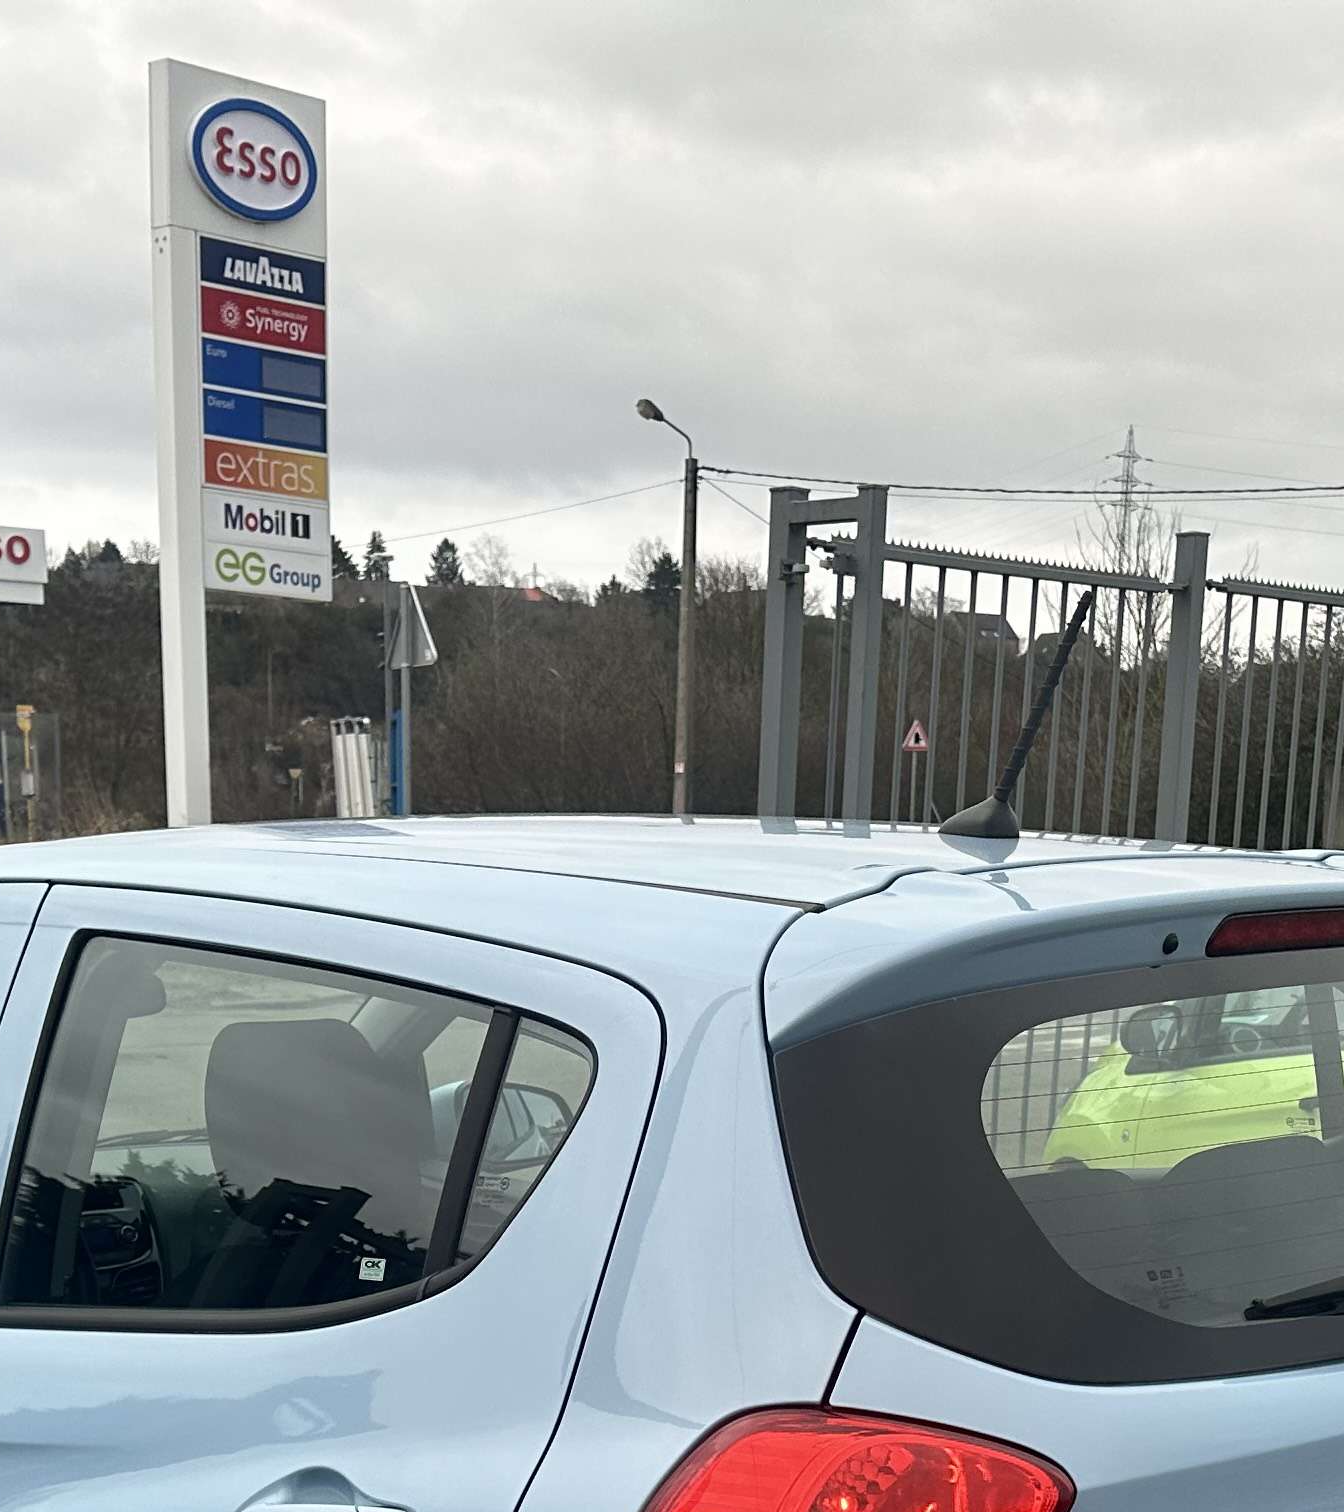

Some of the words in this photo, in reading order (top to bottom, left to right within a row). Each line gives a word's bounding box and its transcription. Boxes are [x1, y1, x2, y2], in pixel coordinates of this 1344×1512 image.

[224, 256, 304, 294] LAVAZZA
[245, 308, 308, 342] Synergy
[216, 451, 314, 493] extras
[224, 503, 286, 536] Mobil
[293, 514, 308, 538] 1
[269, 563, 322, 592] Group
